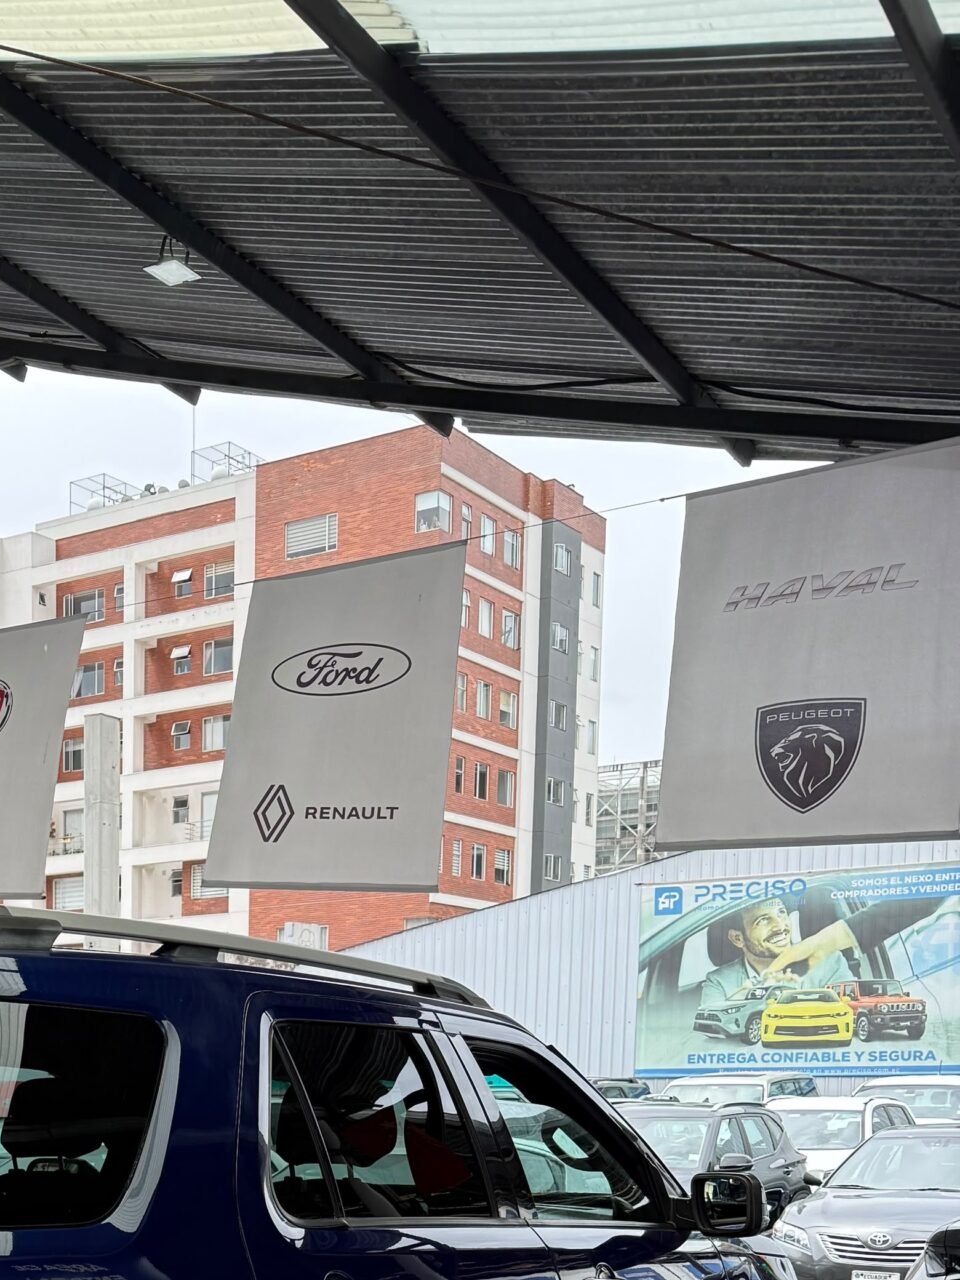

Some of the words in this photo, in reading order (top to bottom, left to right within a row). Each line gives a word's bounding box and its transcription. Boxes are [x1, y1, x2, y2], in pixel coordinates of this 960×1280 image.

[722, 562, 919, 613] HAVAL
[296, 650, 385, 688] Ford
[766, 707, 856, 723] PEUGEOT
[304, 806, 399, 820] RENAULT
[851, 877, 888, 887] SOMOS
[890, 876, 903, 885] EL
[904, 873, 933, 883] NEXO
[694, 878, 807, 903] PRECISO
[830, 886, 910, 900] COMPRADORES
[910, 886, 920, 894] Y
[687, 1052, 758, 1064] ENTREGA
[760, 1051, 851, 1064] CONFIABLE
[854, 1051, 865, 1062] Y
[867, 1050, 937, 1062] SEGURA
